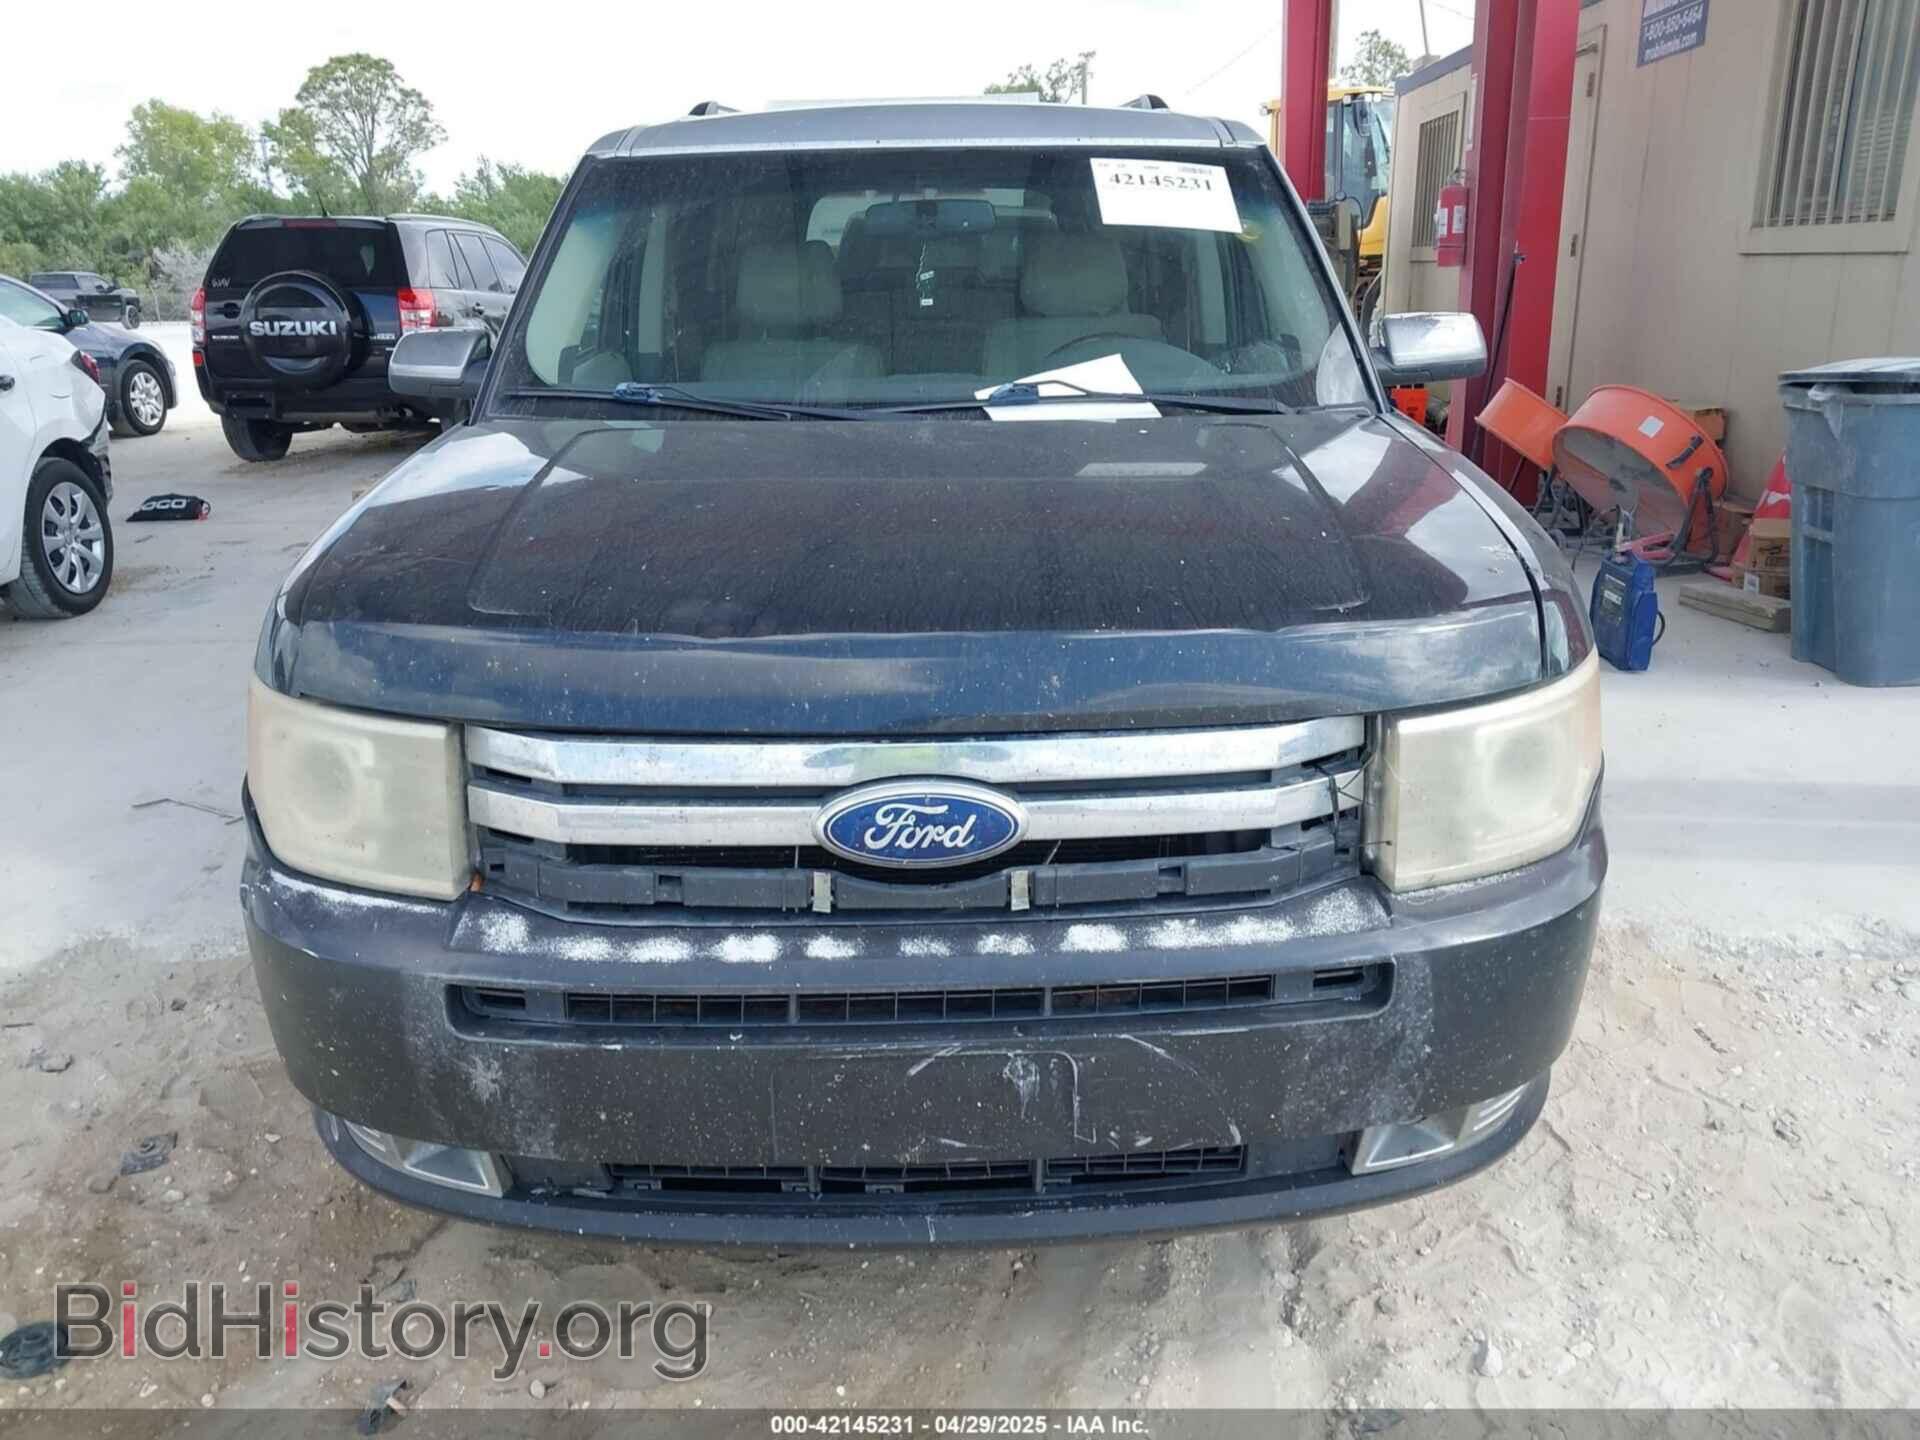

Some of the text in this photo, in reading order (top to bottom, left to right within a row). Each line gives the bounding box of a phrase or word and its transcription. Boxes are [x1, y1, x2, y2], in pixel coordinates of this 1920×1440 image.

[1109, 173, 1212, 191] 42145231
[249, 320, 338, 337] SUZUKI
[864, 803, 977, 850] Ford
